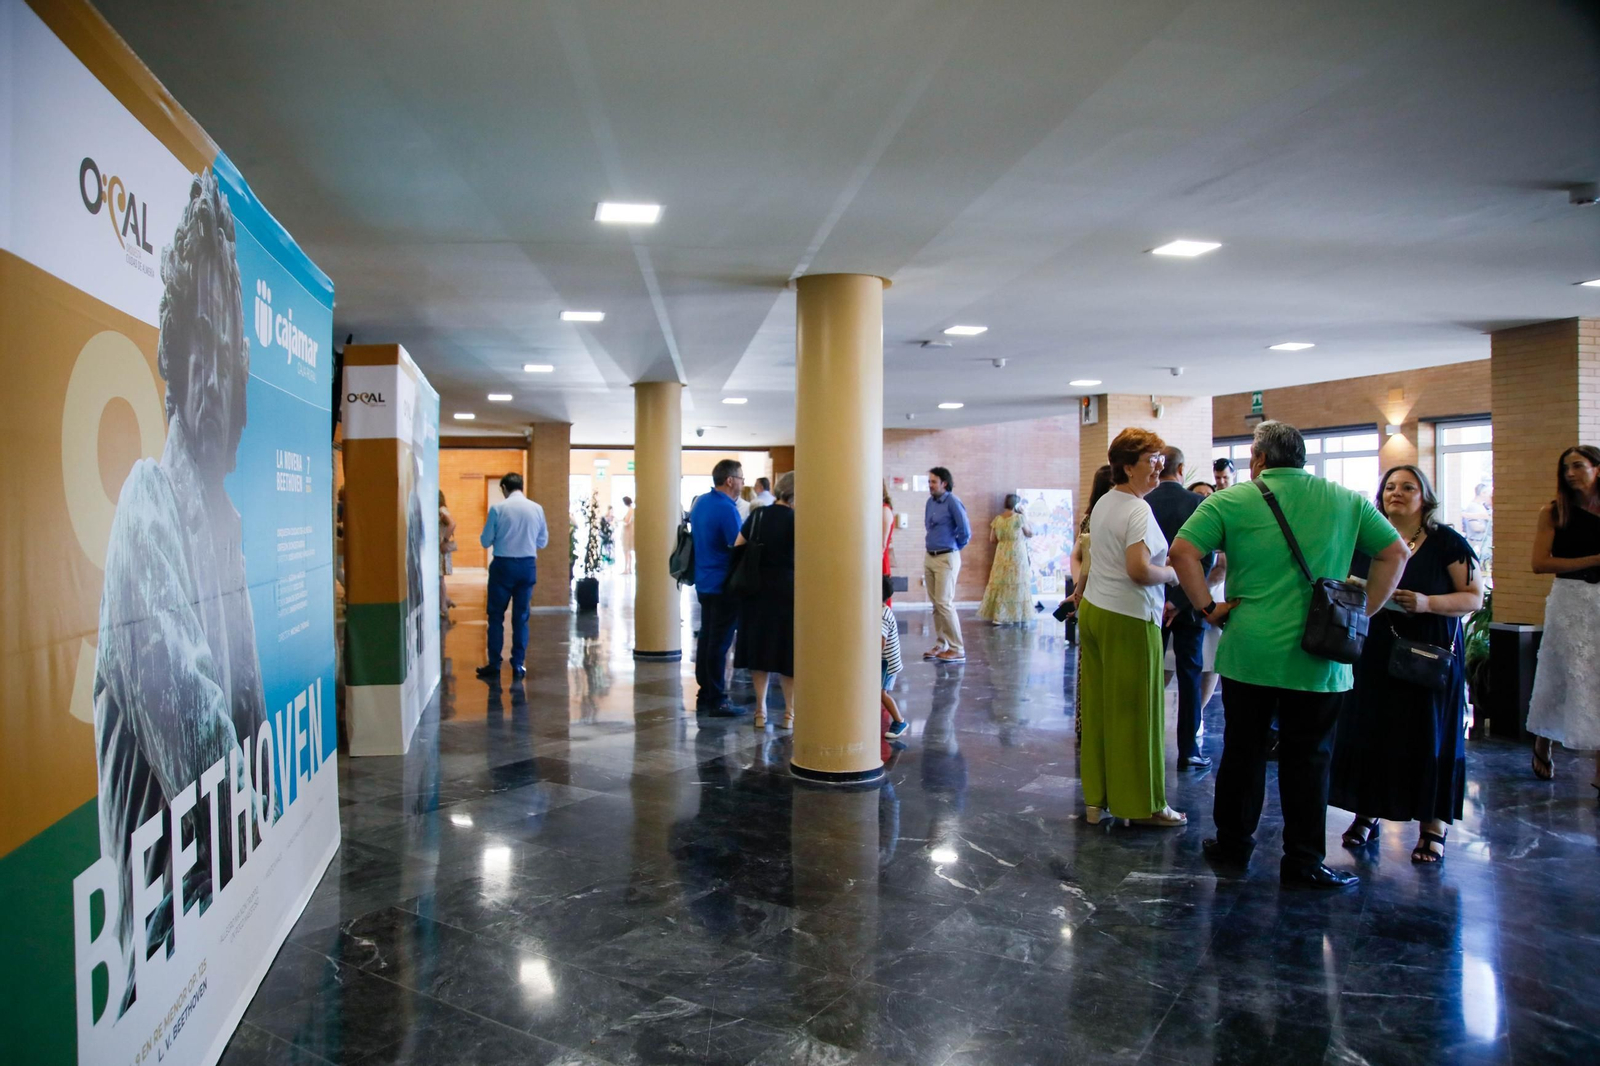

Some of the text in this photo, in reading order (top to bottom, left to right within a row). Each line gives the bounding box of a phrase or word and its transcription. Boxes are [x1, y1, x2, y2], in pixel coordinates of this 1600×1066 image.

[275, 308, 318, 369] cajamar
[276, 449, 284, 469] LA
[73, 677, 324, 1040] BEETHOVEN
[141, 1037, 152, 1061] EN
[153, 1022, 163, 1046] RE
[164, 987, 188, 1031] MENOR
[173, 977, 208, 1041] BEETHOVEN
